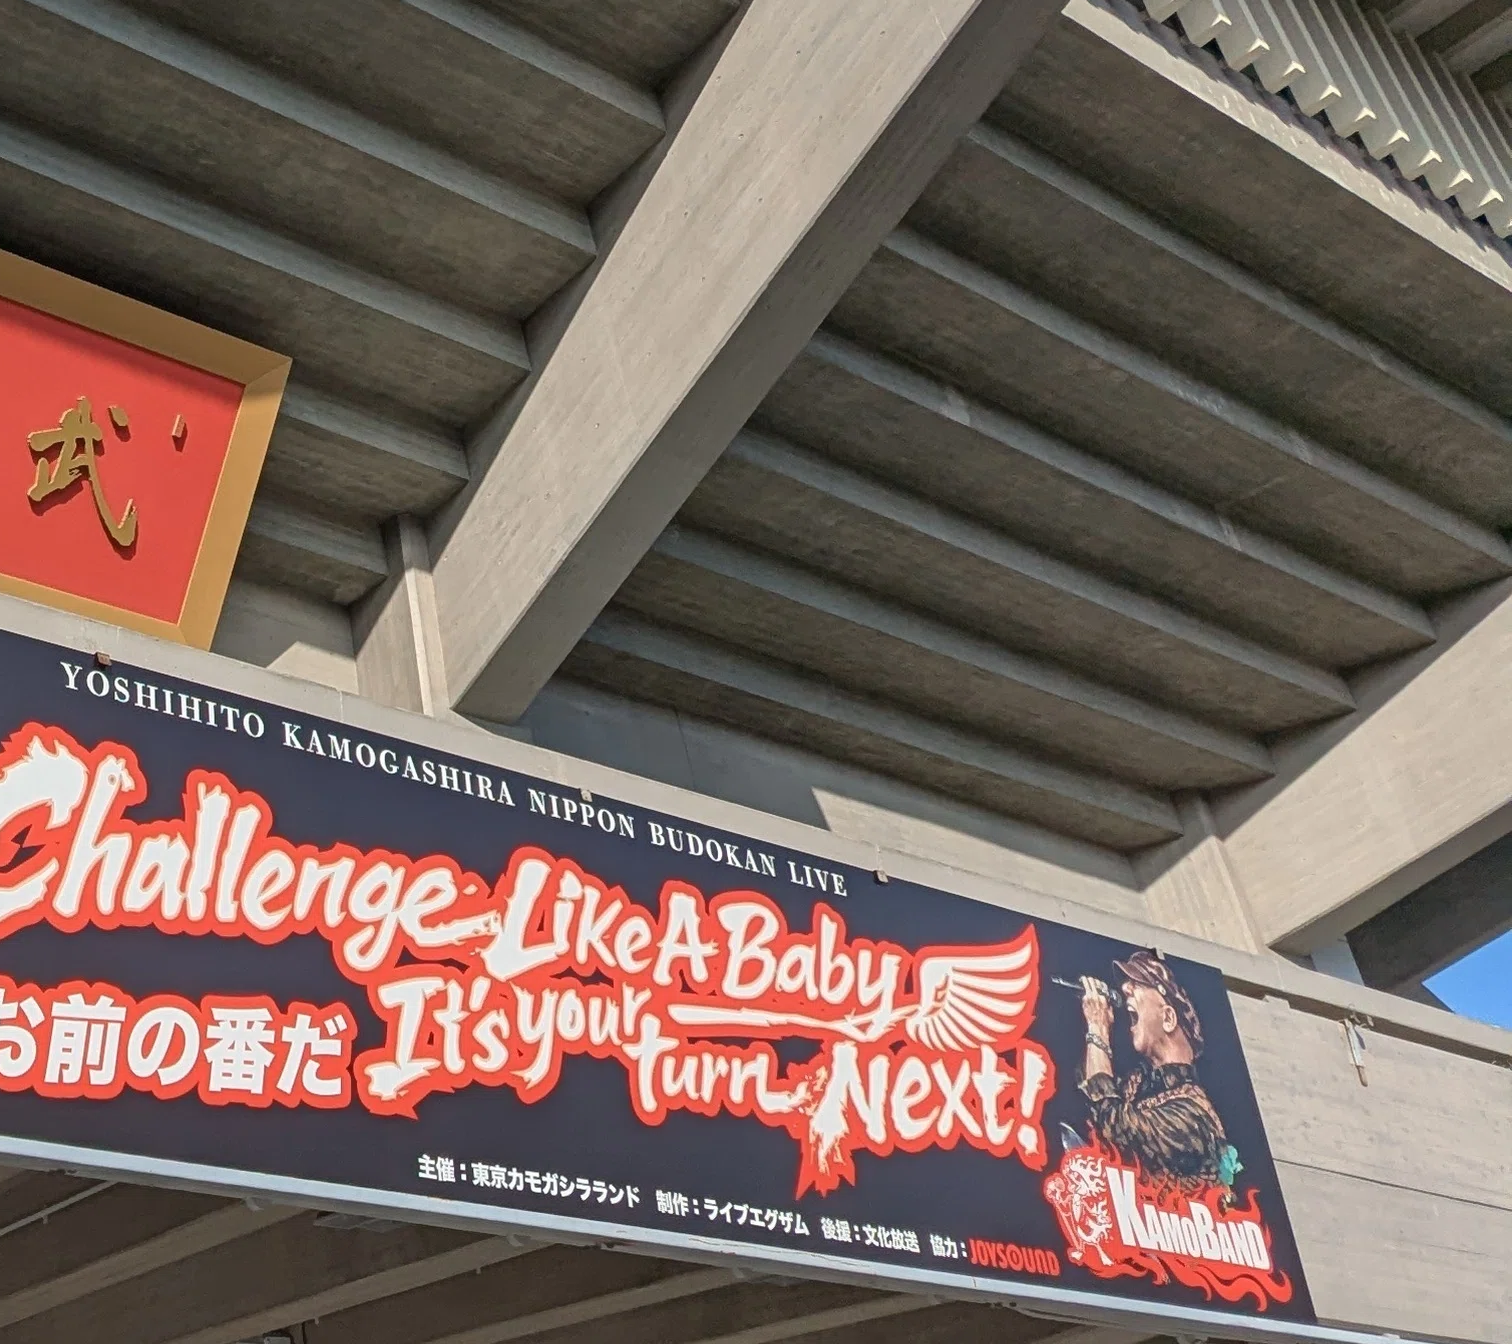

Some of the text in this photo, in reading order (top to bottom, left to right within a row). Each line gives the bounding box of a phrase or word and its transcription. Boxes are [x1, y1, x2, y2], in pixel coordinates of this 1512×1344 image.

[60, 661, 848, 898] YOSHIHITO KAMOGASHIRA NIPPON BUDOKAN LIVE
[366, 976, 651, 1101] It's your
[718, 902, 903, 1036] Baby
[621, 1014, 1048, 1168] turn Next!
